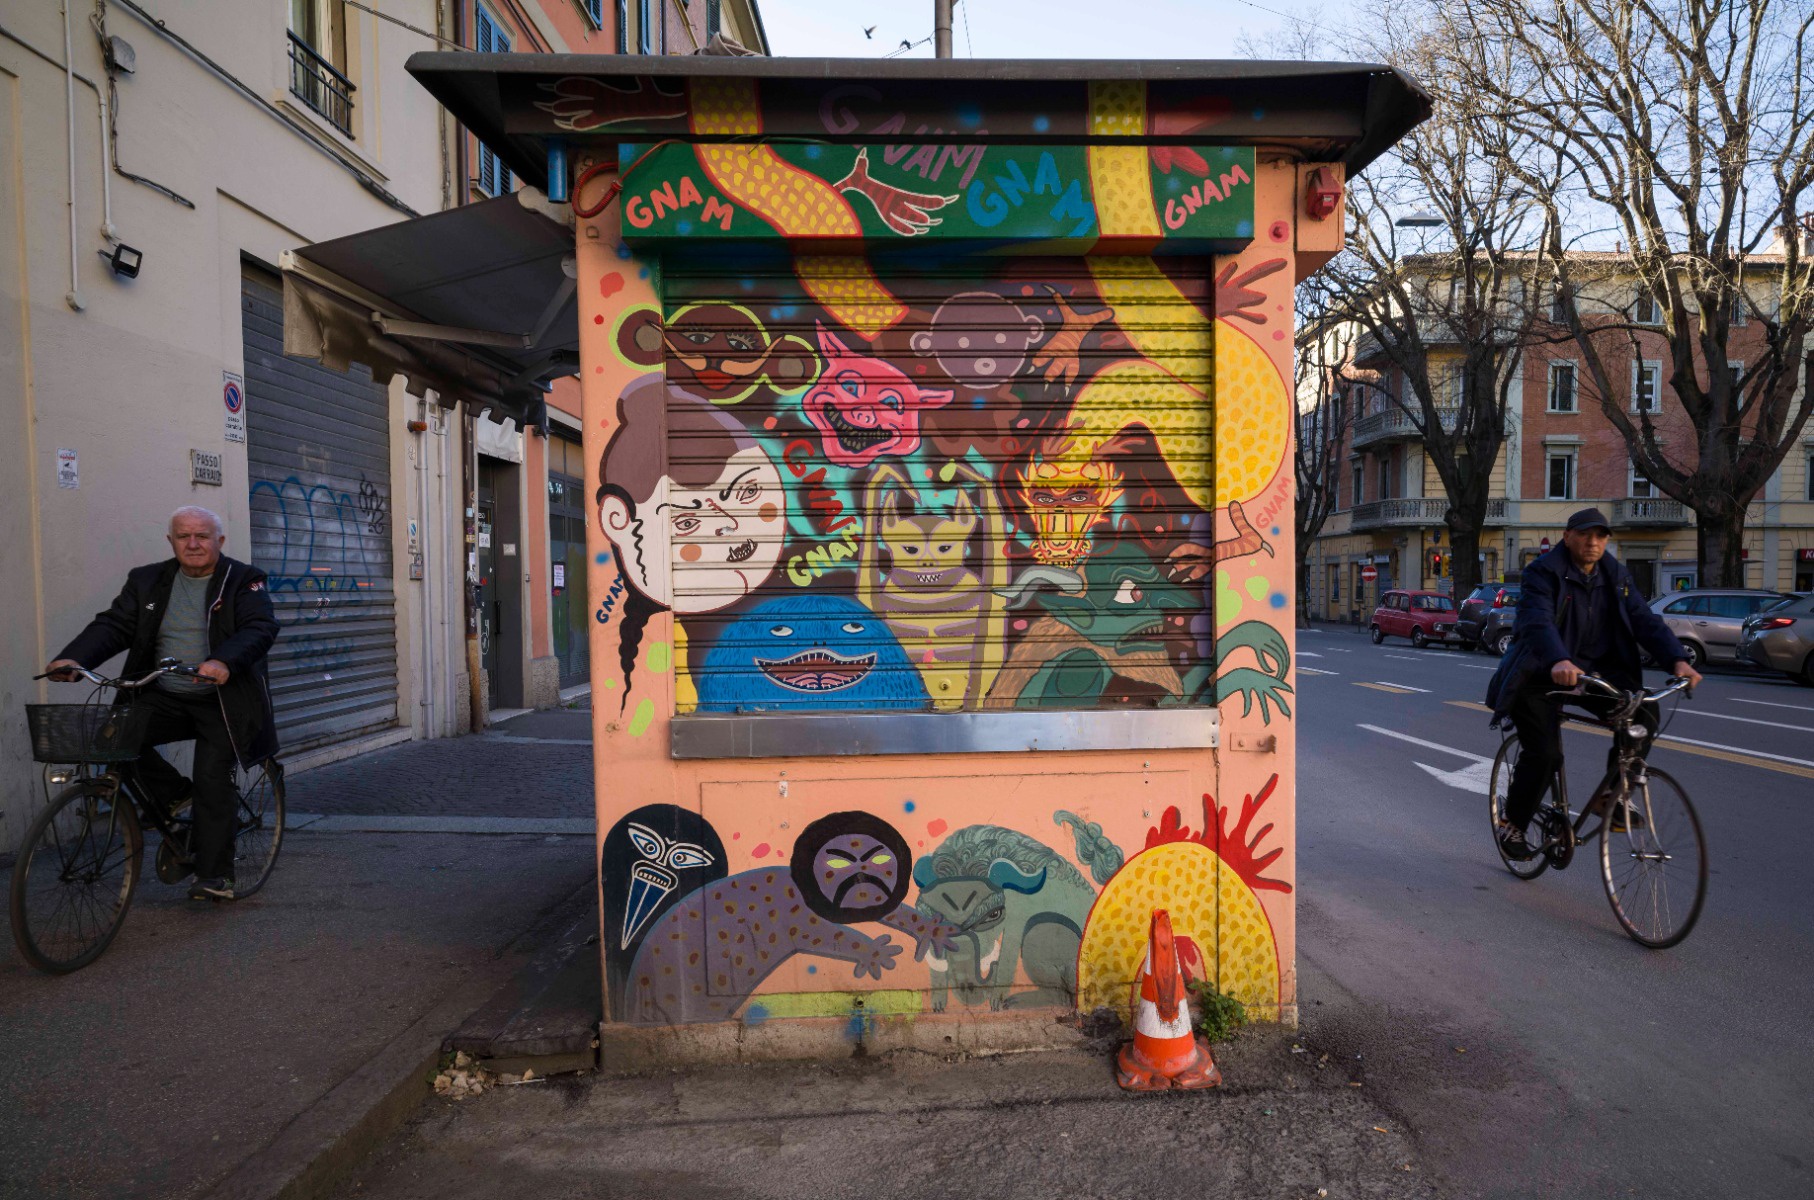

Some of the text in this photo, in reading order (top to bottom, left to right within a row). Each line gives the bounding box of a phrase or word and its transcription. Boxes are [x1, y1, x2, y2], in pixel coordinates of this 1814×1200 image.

[625, 176, 734, 231] GNAM
[967, 151, 1097, 238] GNAM
[1165, 164, 1251, 230] GNAM
[196, 453, 218, 468] PASSO
[1255, 476, 1292, 529] GNAM
[787, 523, 863, 587] GNAM
[596, 572, 624, 624] GNAM
